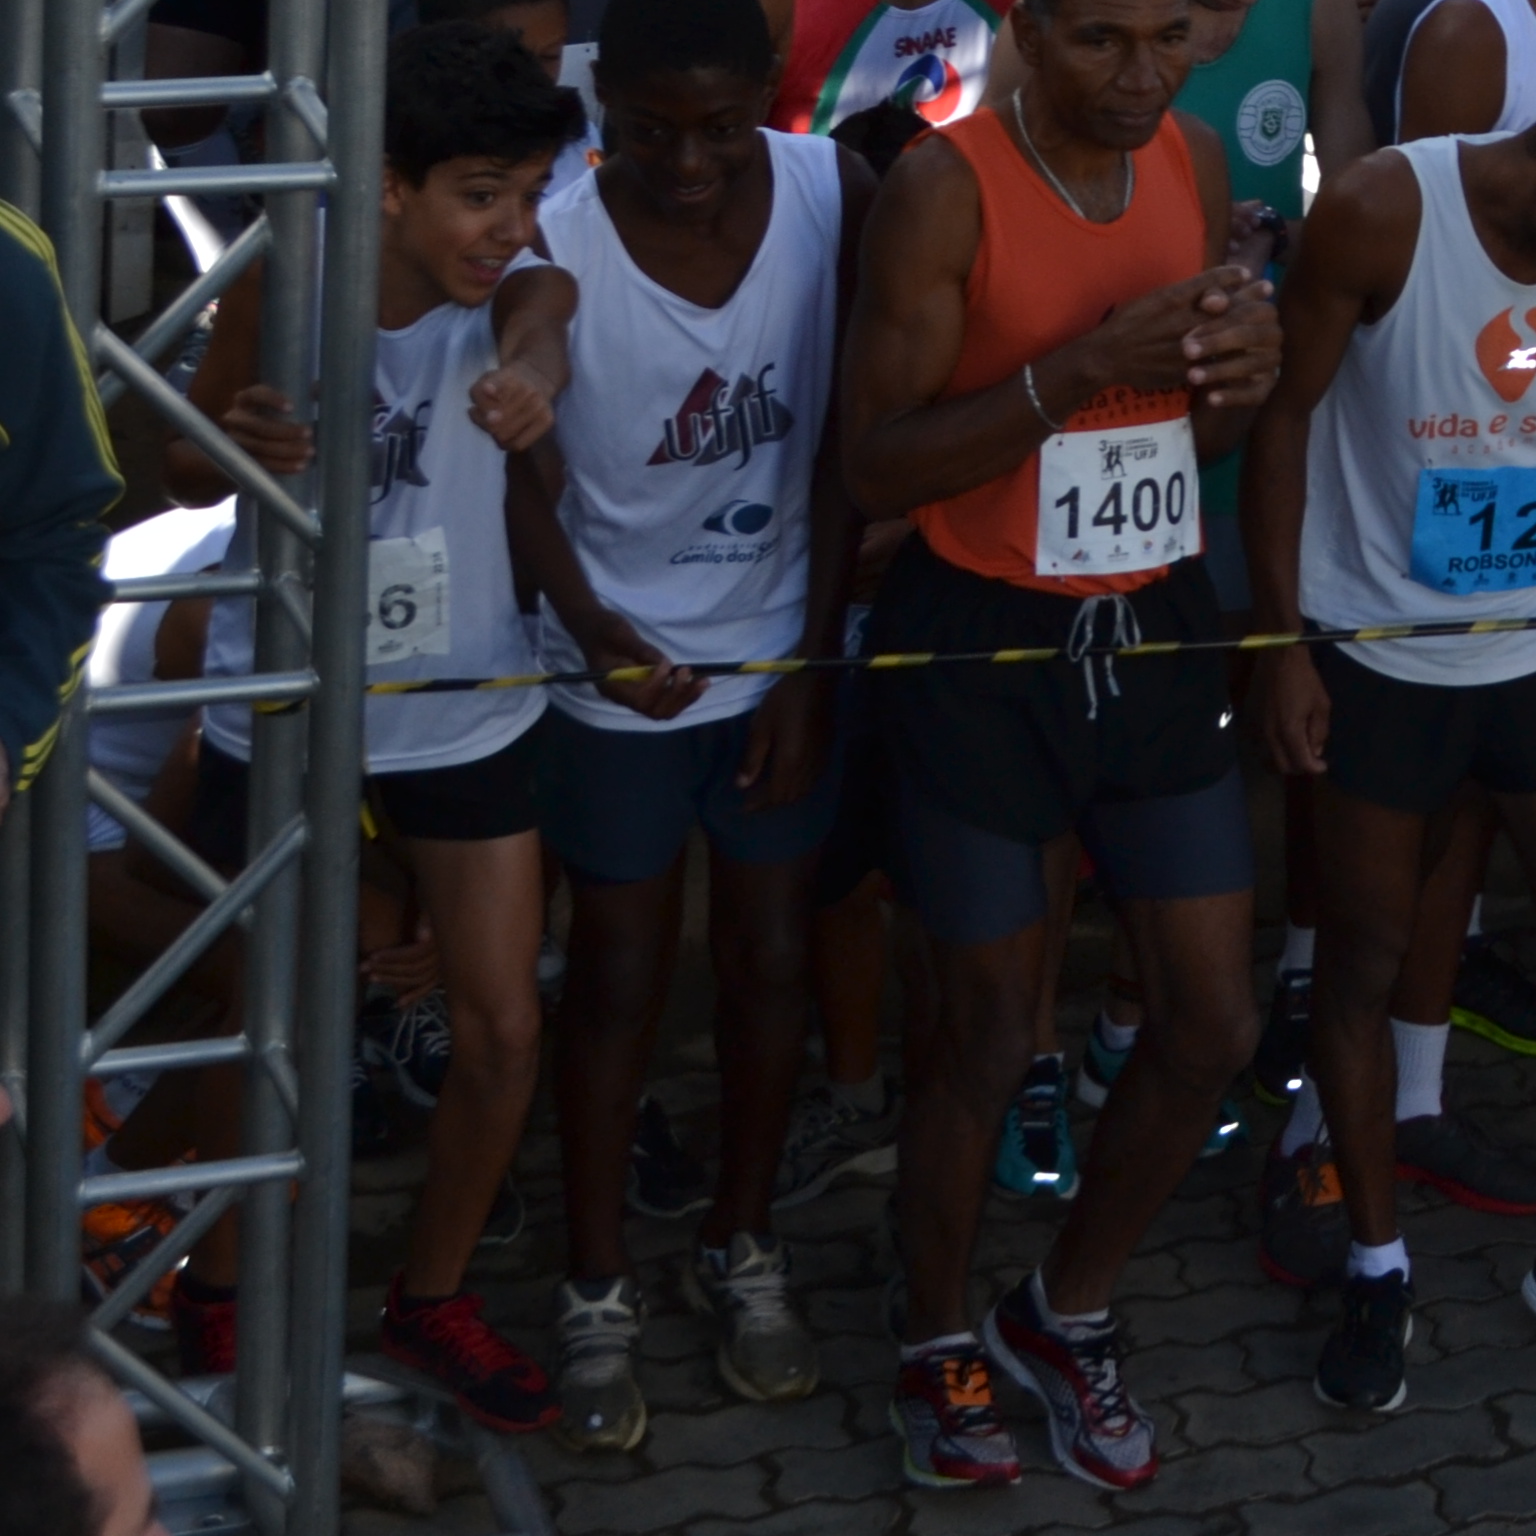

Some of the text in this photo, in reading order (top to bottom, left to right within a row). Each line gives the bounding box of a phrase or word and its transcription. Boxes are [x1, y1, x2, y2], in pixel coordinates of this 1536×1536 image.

[894, 28, 957, 58] SINAAE
[1409, 412, 1460, 440] vida
[1489, 413, 1507, 435] e
[1055, 470, 1185, 540] 1400
